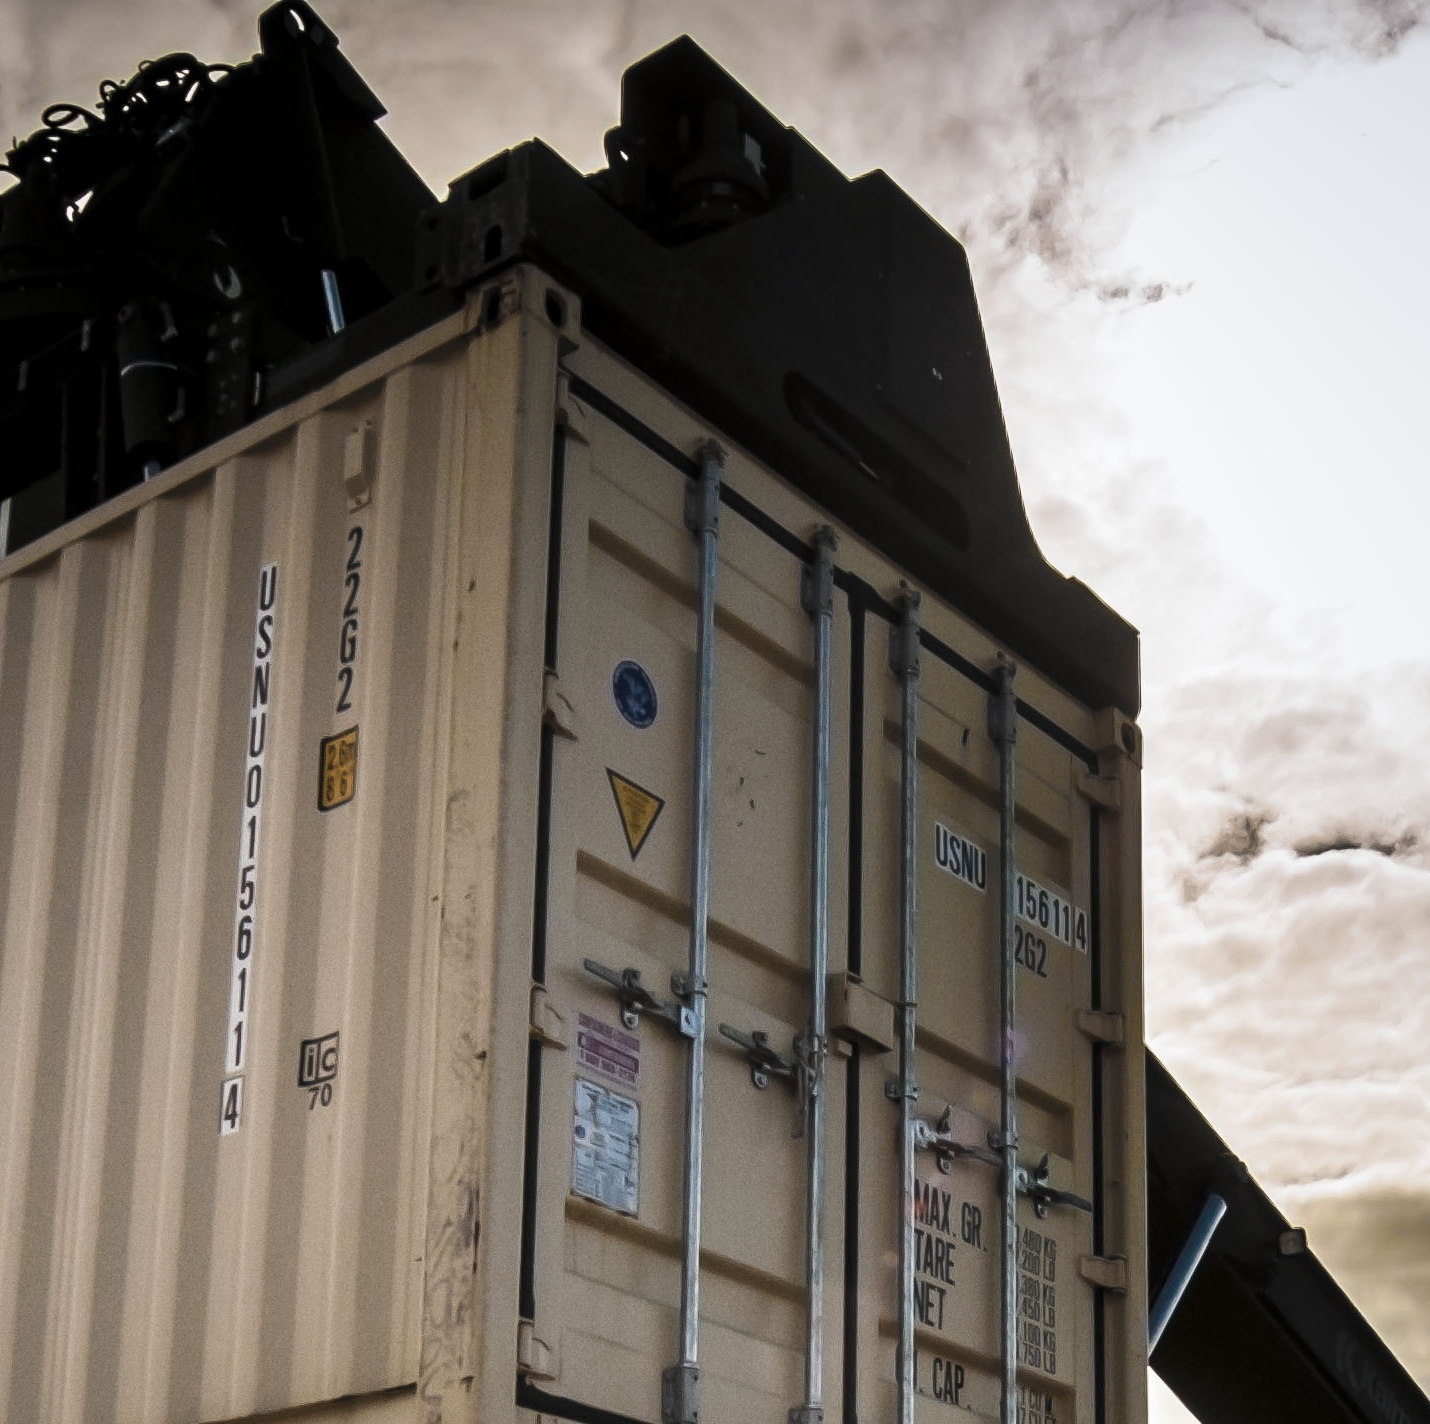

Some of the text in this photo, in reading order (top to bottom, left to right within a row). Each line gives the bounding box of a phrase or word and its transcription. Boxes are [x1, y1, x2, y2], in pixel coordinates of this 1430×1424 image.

[336, 526, 363, 712] 22G2
[935, 824, 986, 890] USNU
[1017, 876, 1070, 944] 15611
[1015, 924, 1047, 978] 2G2
[308, 1083, 332, 1110] 70
[961, 1202, 988, 1253] GR.
[914, 1228, 955, 1287] TARE
[914, 1277, 947, 1330] NET
[932, 1357, 971, 1409] CAP.
